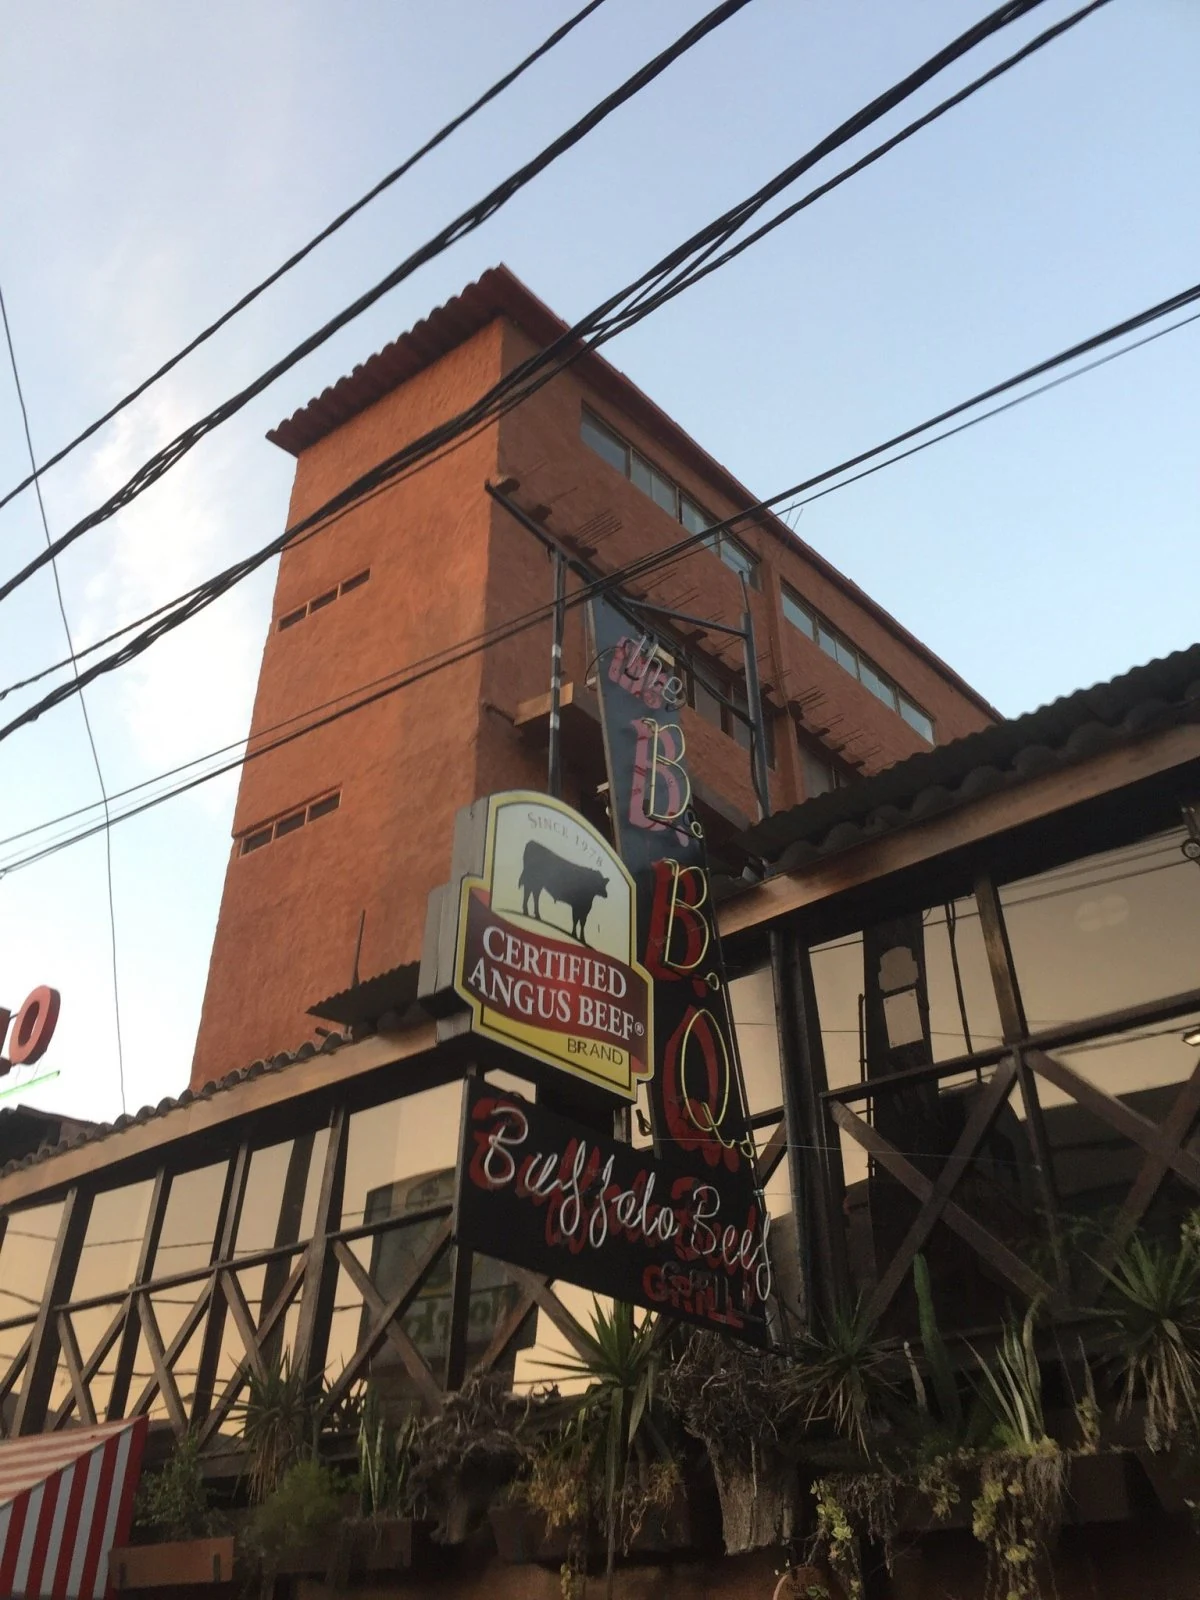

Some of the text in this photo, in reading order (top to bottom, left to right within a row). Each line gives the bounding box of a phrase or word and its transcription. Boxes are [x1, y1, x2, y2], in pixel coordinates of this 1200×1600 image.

[527, 811, 569, 839] SINCE
[468, 957, 571, 1024] ANGUS
[482, 925, 627, 999] CERTIFIED
[567, 1037, 624, 1066] BRAND
[469, 1096, 772, 1302] Buffalo Beef
